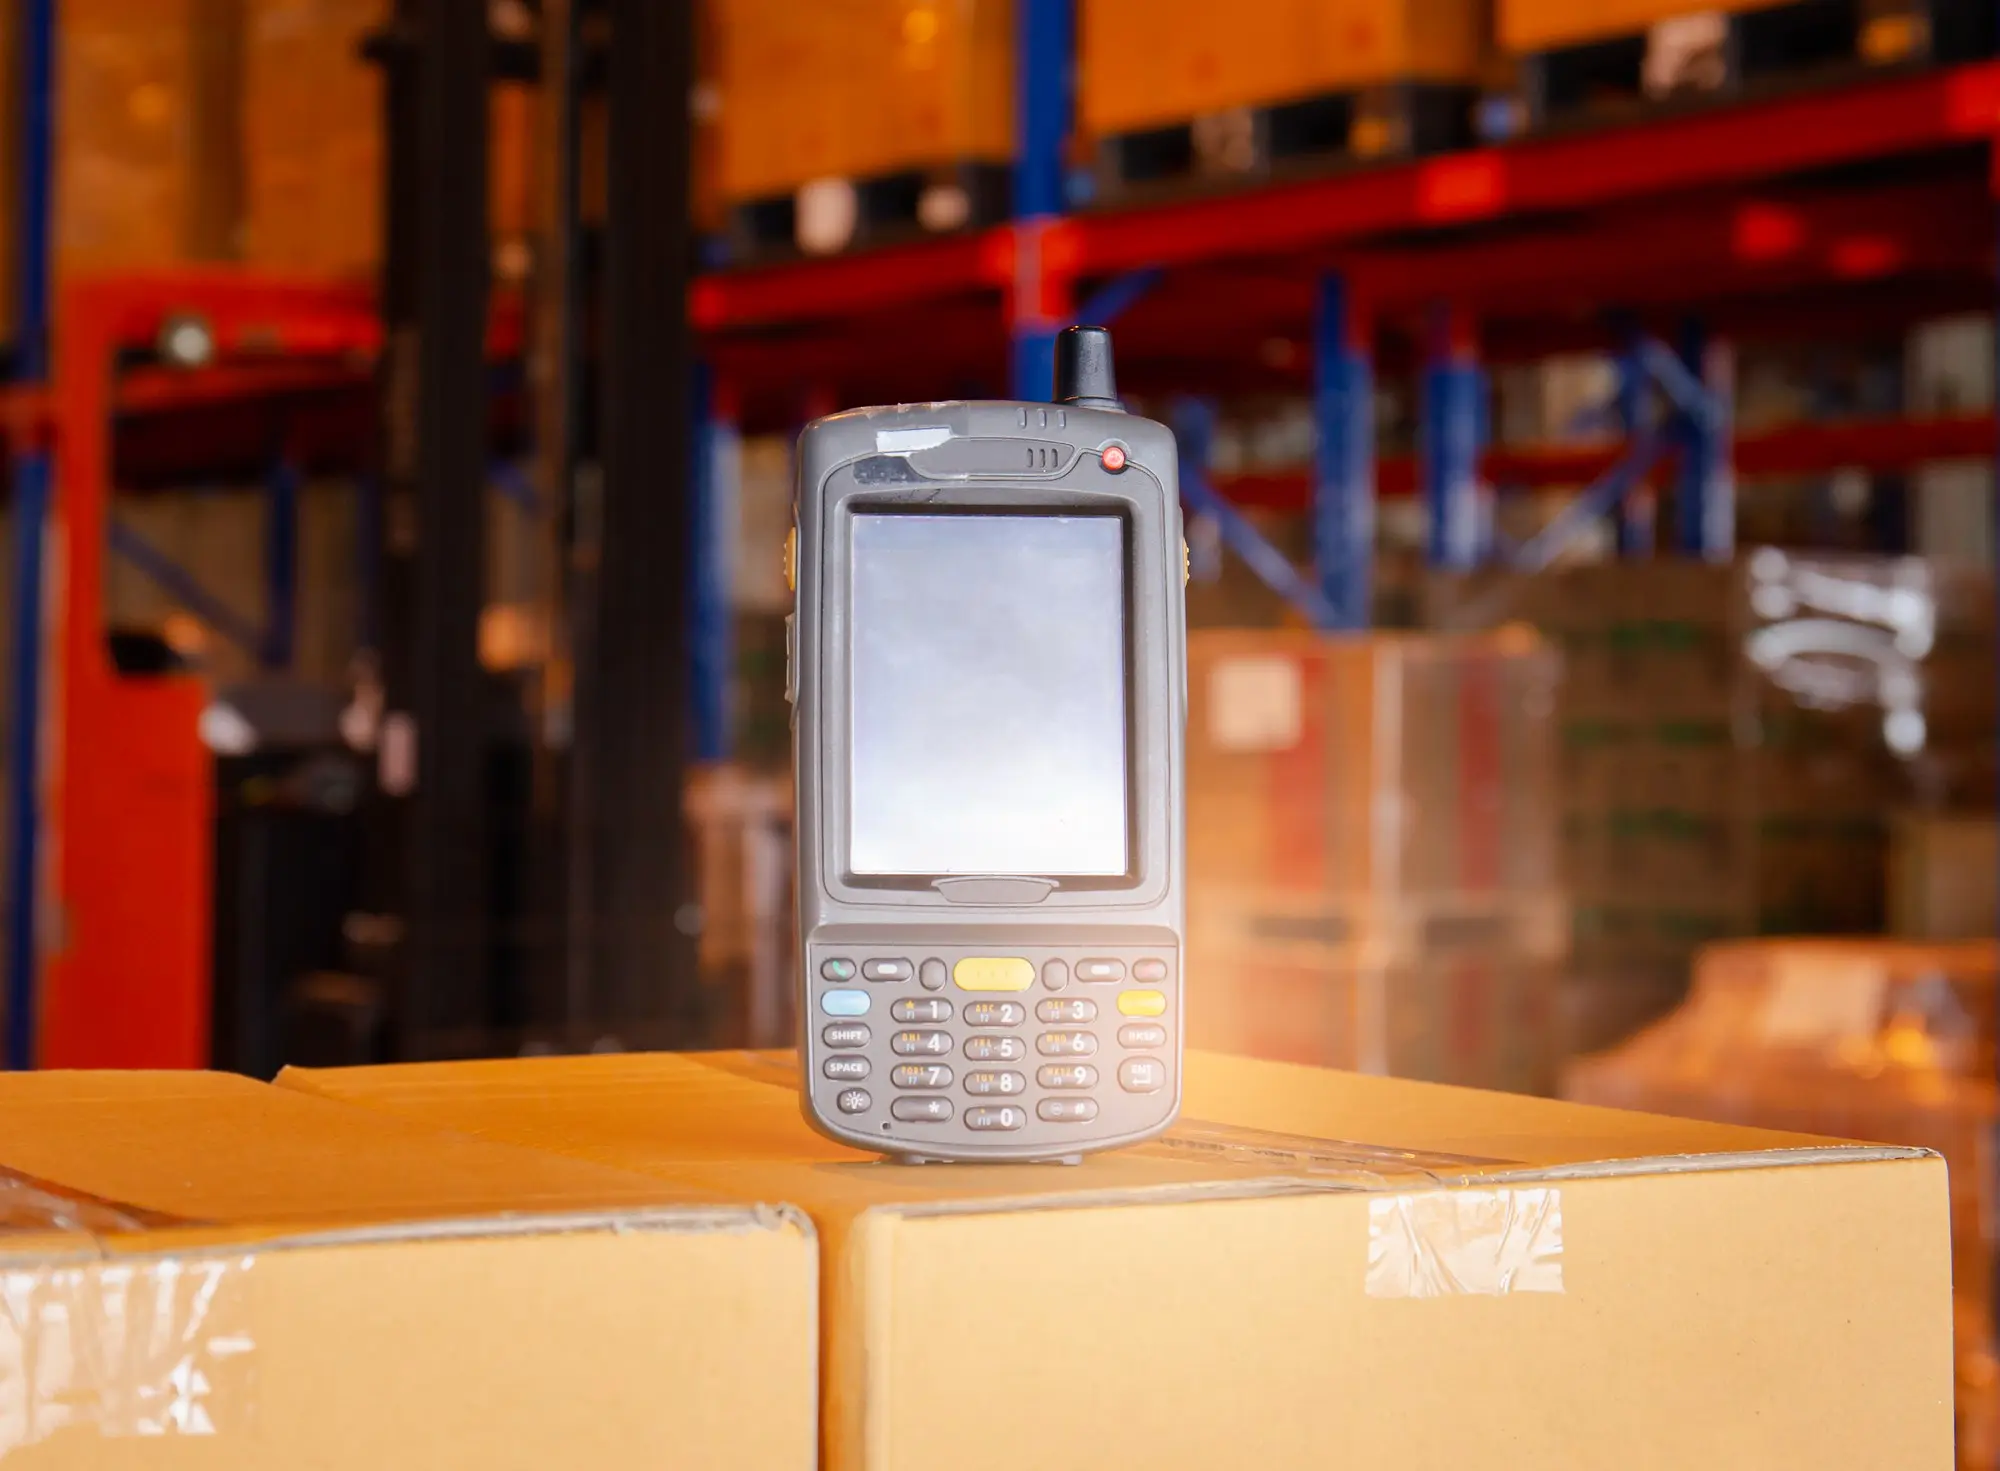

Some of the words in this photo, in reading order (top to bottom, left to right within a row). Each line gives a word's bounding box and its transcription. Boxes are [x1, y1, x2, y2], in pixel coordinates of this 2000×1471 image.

[930, 1001, 938, 1019] 1
[975, 1004, 994, 1013] ABC
[1000, 1004, 1013, 1022] 2
[1072, 1001, 1084, 1019] 3
[831, 1031, 863, 1040] SHIFT
[927, 1034, 940, 1051] 4
[1072, 1033, 1085, 1051] 6
[1000, 1039, 1012, 1057] 5
[830, 1063, 863, 1072] SPACE
[928, 1067, 940, 1085] 7
[1074, 1067, 1086, 1085] 9
[1131, 1064, 1152, 1074] ENT
[1000, 1073, 1013, 1092] 8
[1000, 1108, 1013, 1127] 0
